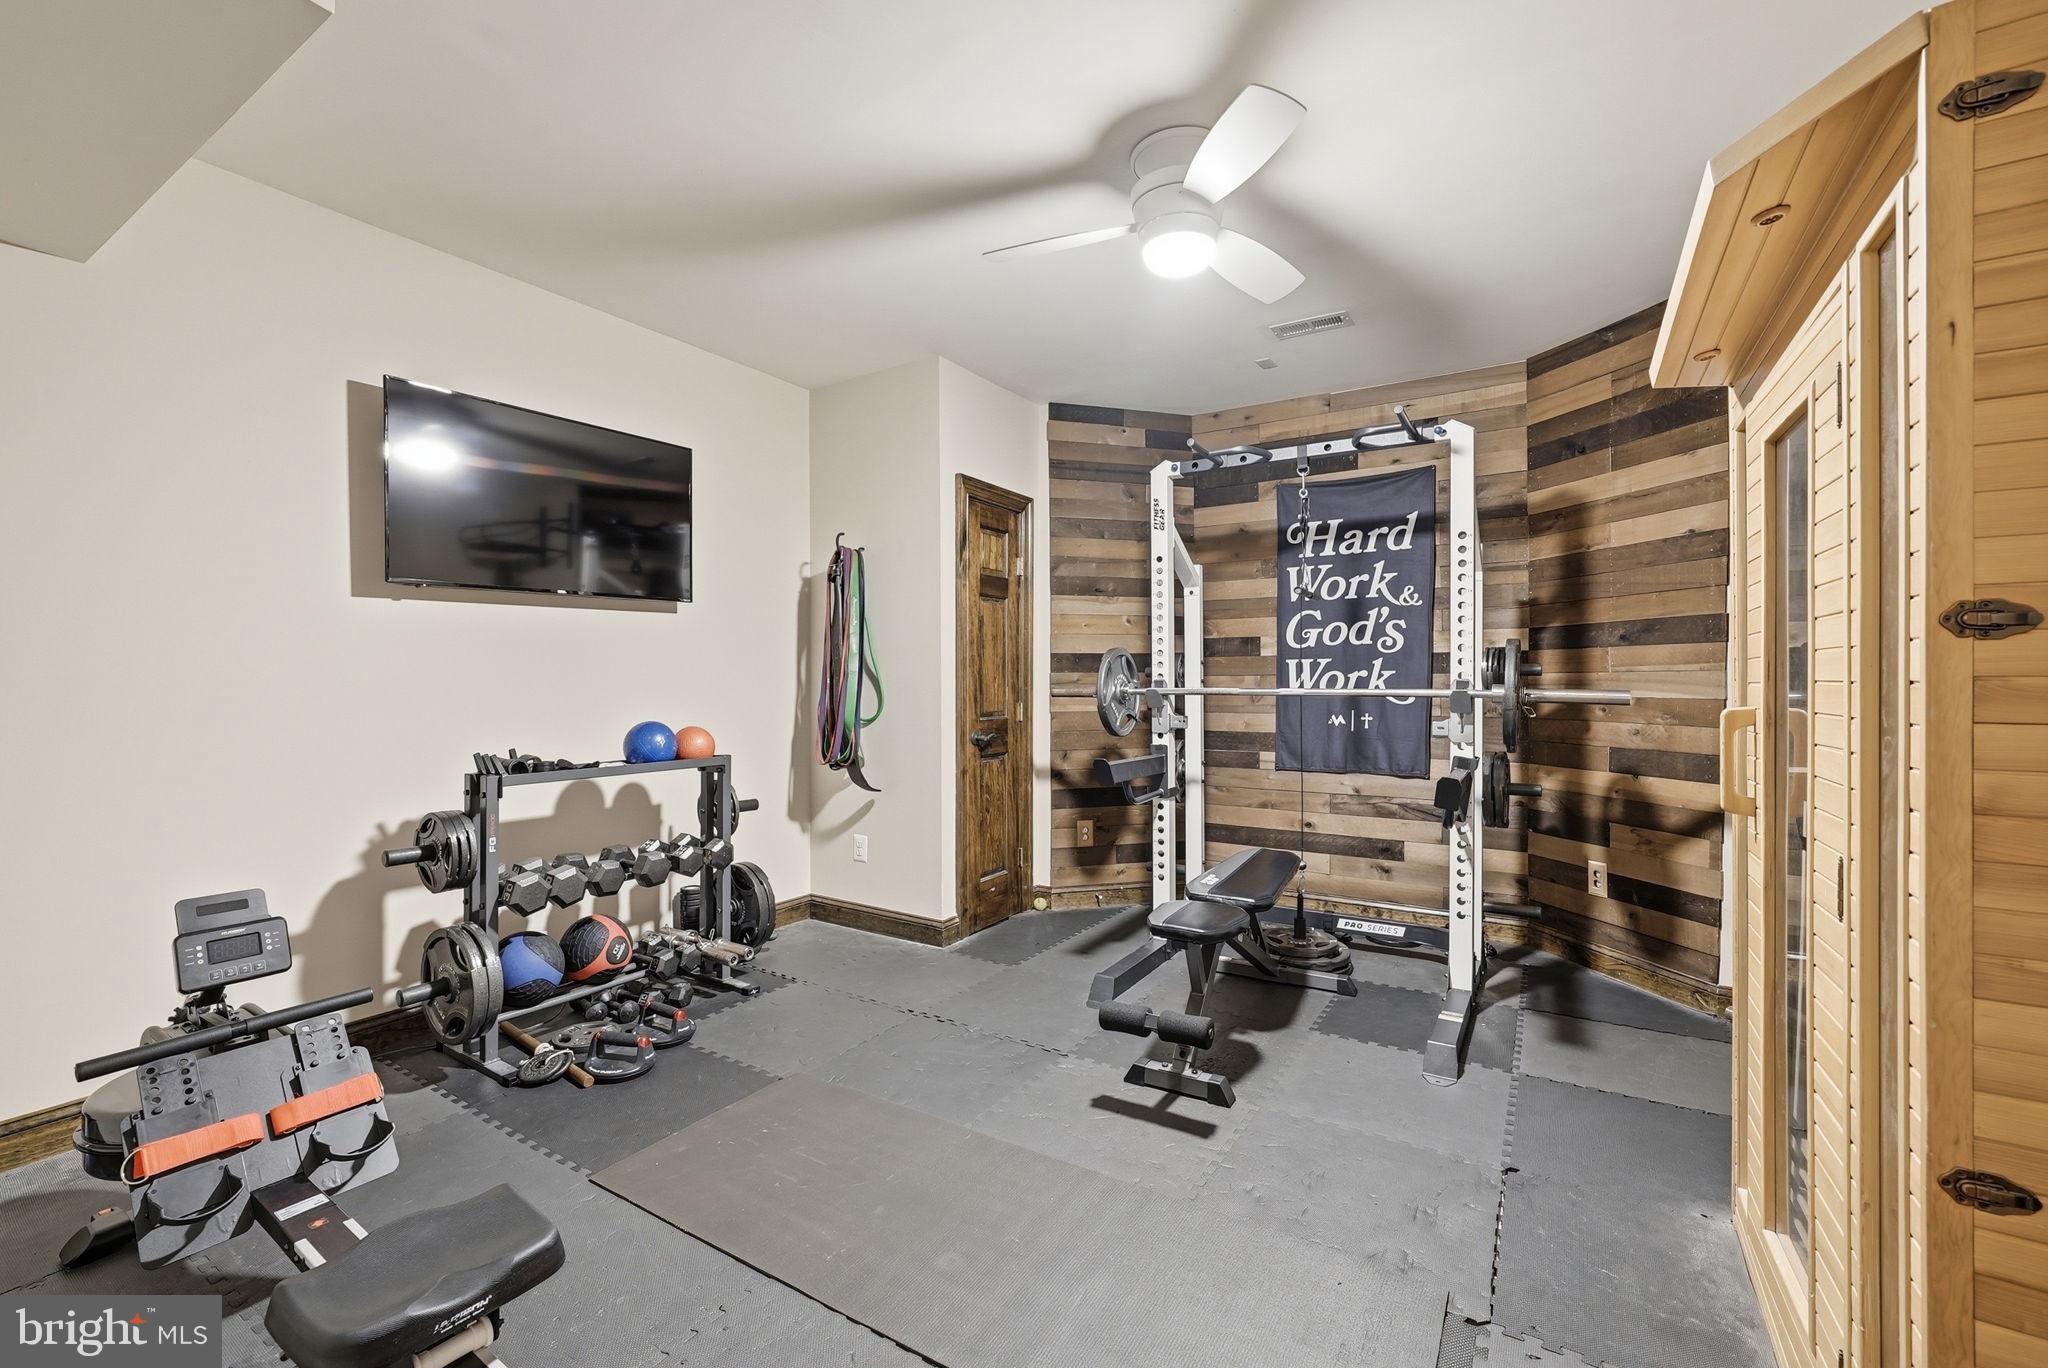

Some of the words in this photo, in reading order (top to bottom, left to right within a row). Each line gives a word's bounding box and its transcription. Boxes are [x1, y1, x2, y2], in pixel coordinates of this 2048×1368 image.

[1286, 510, 1418, 558] Hard
[1286, 560, 1402, 606] Work
[1285, 606, 1407, 653] God's
[1286, 657, 1416, 705] Work
[1344, 921, 1363, 929] PRO
[1367, 924, 1398, 935] SERIES
